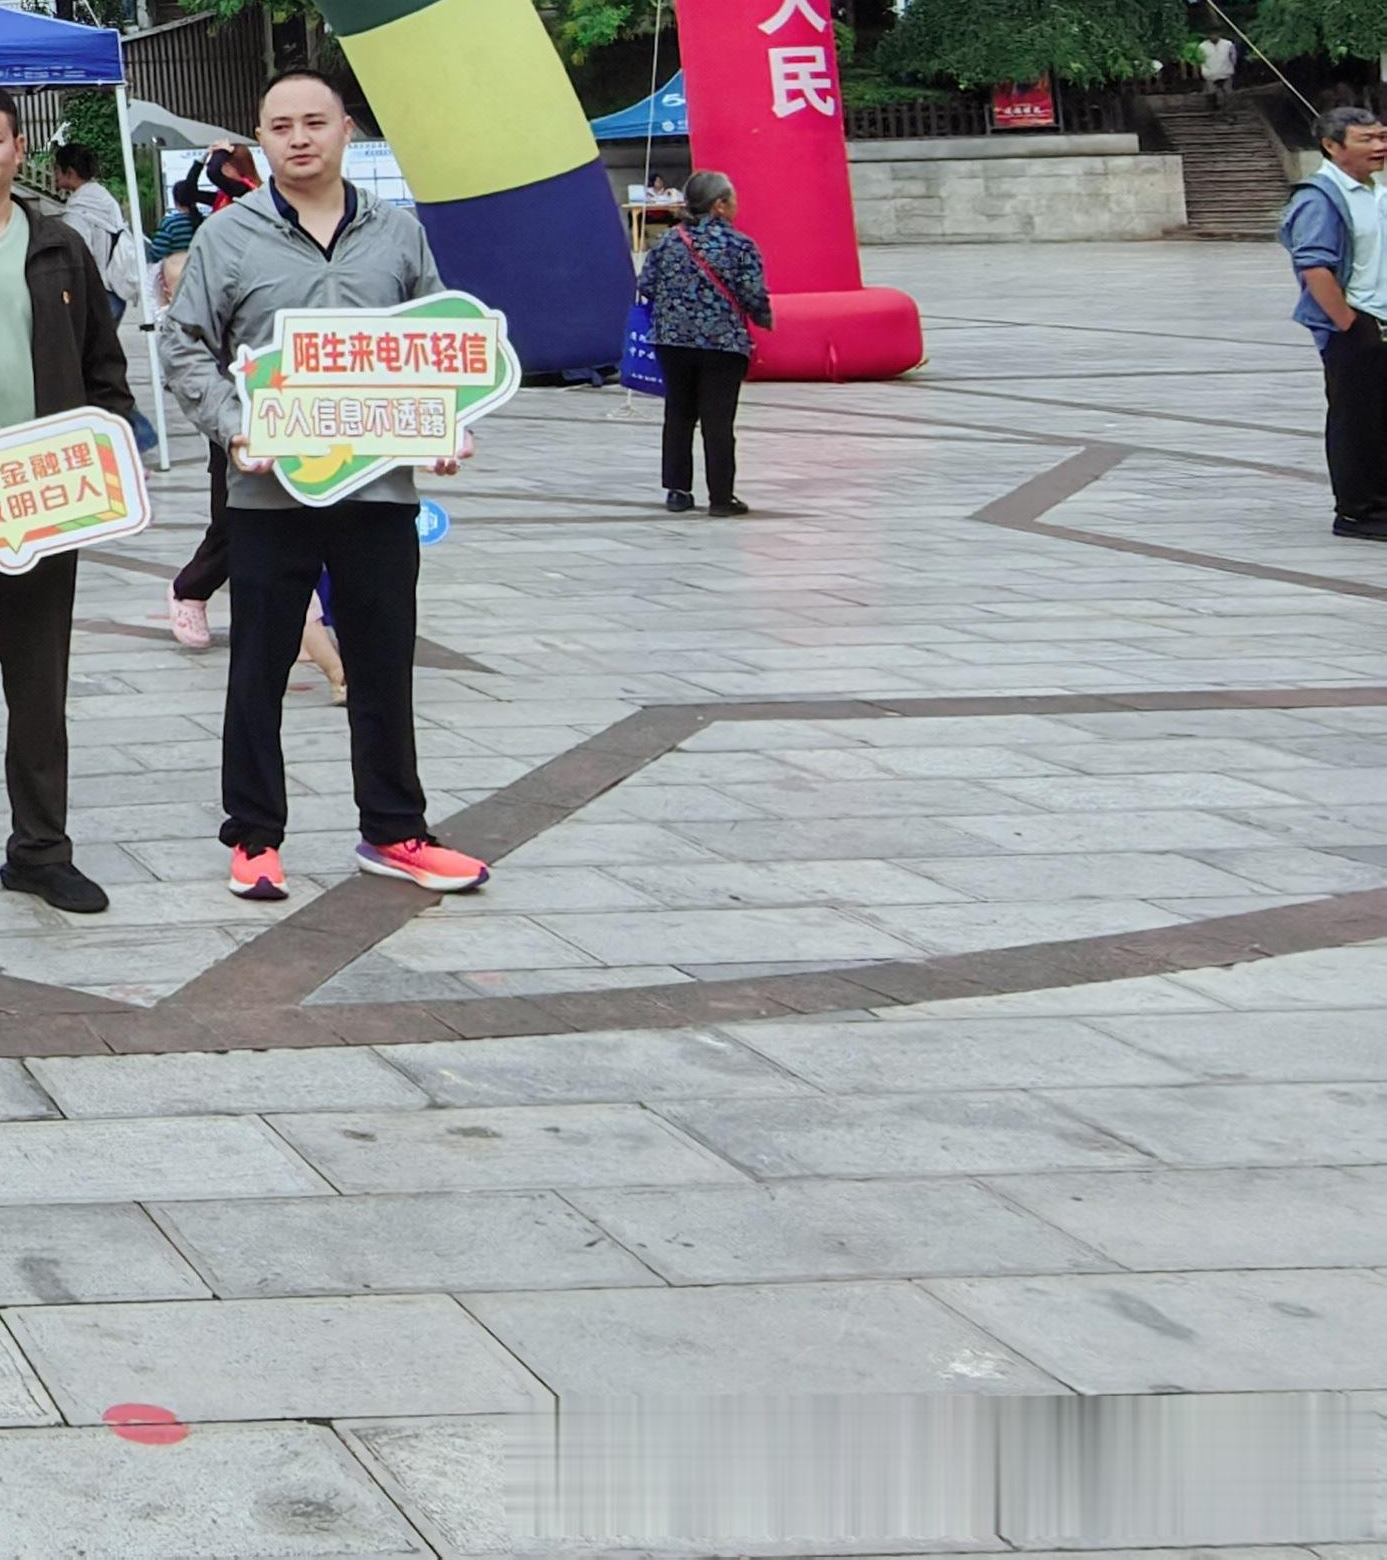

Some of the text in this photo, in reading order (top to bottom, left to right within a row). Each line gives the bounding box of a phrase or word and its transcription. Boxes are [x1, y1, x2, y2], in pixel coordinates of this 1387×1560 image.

[292, 331, 488, 374] 陌生来电不轻信
[259, 397, 447, 438] 个人信息不透露
